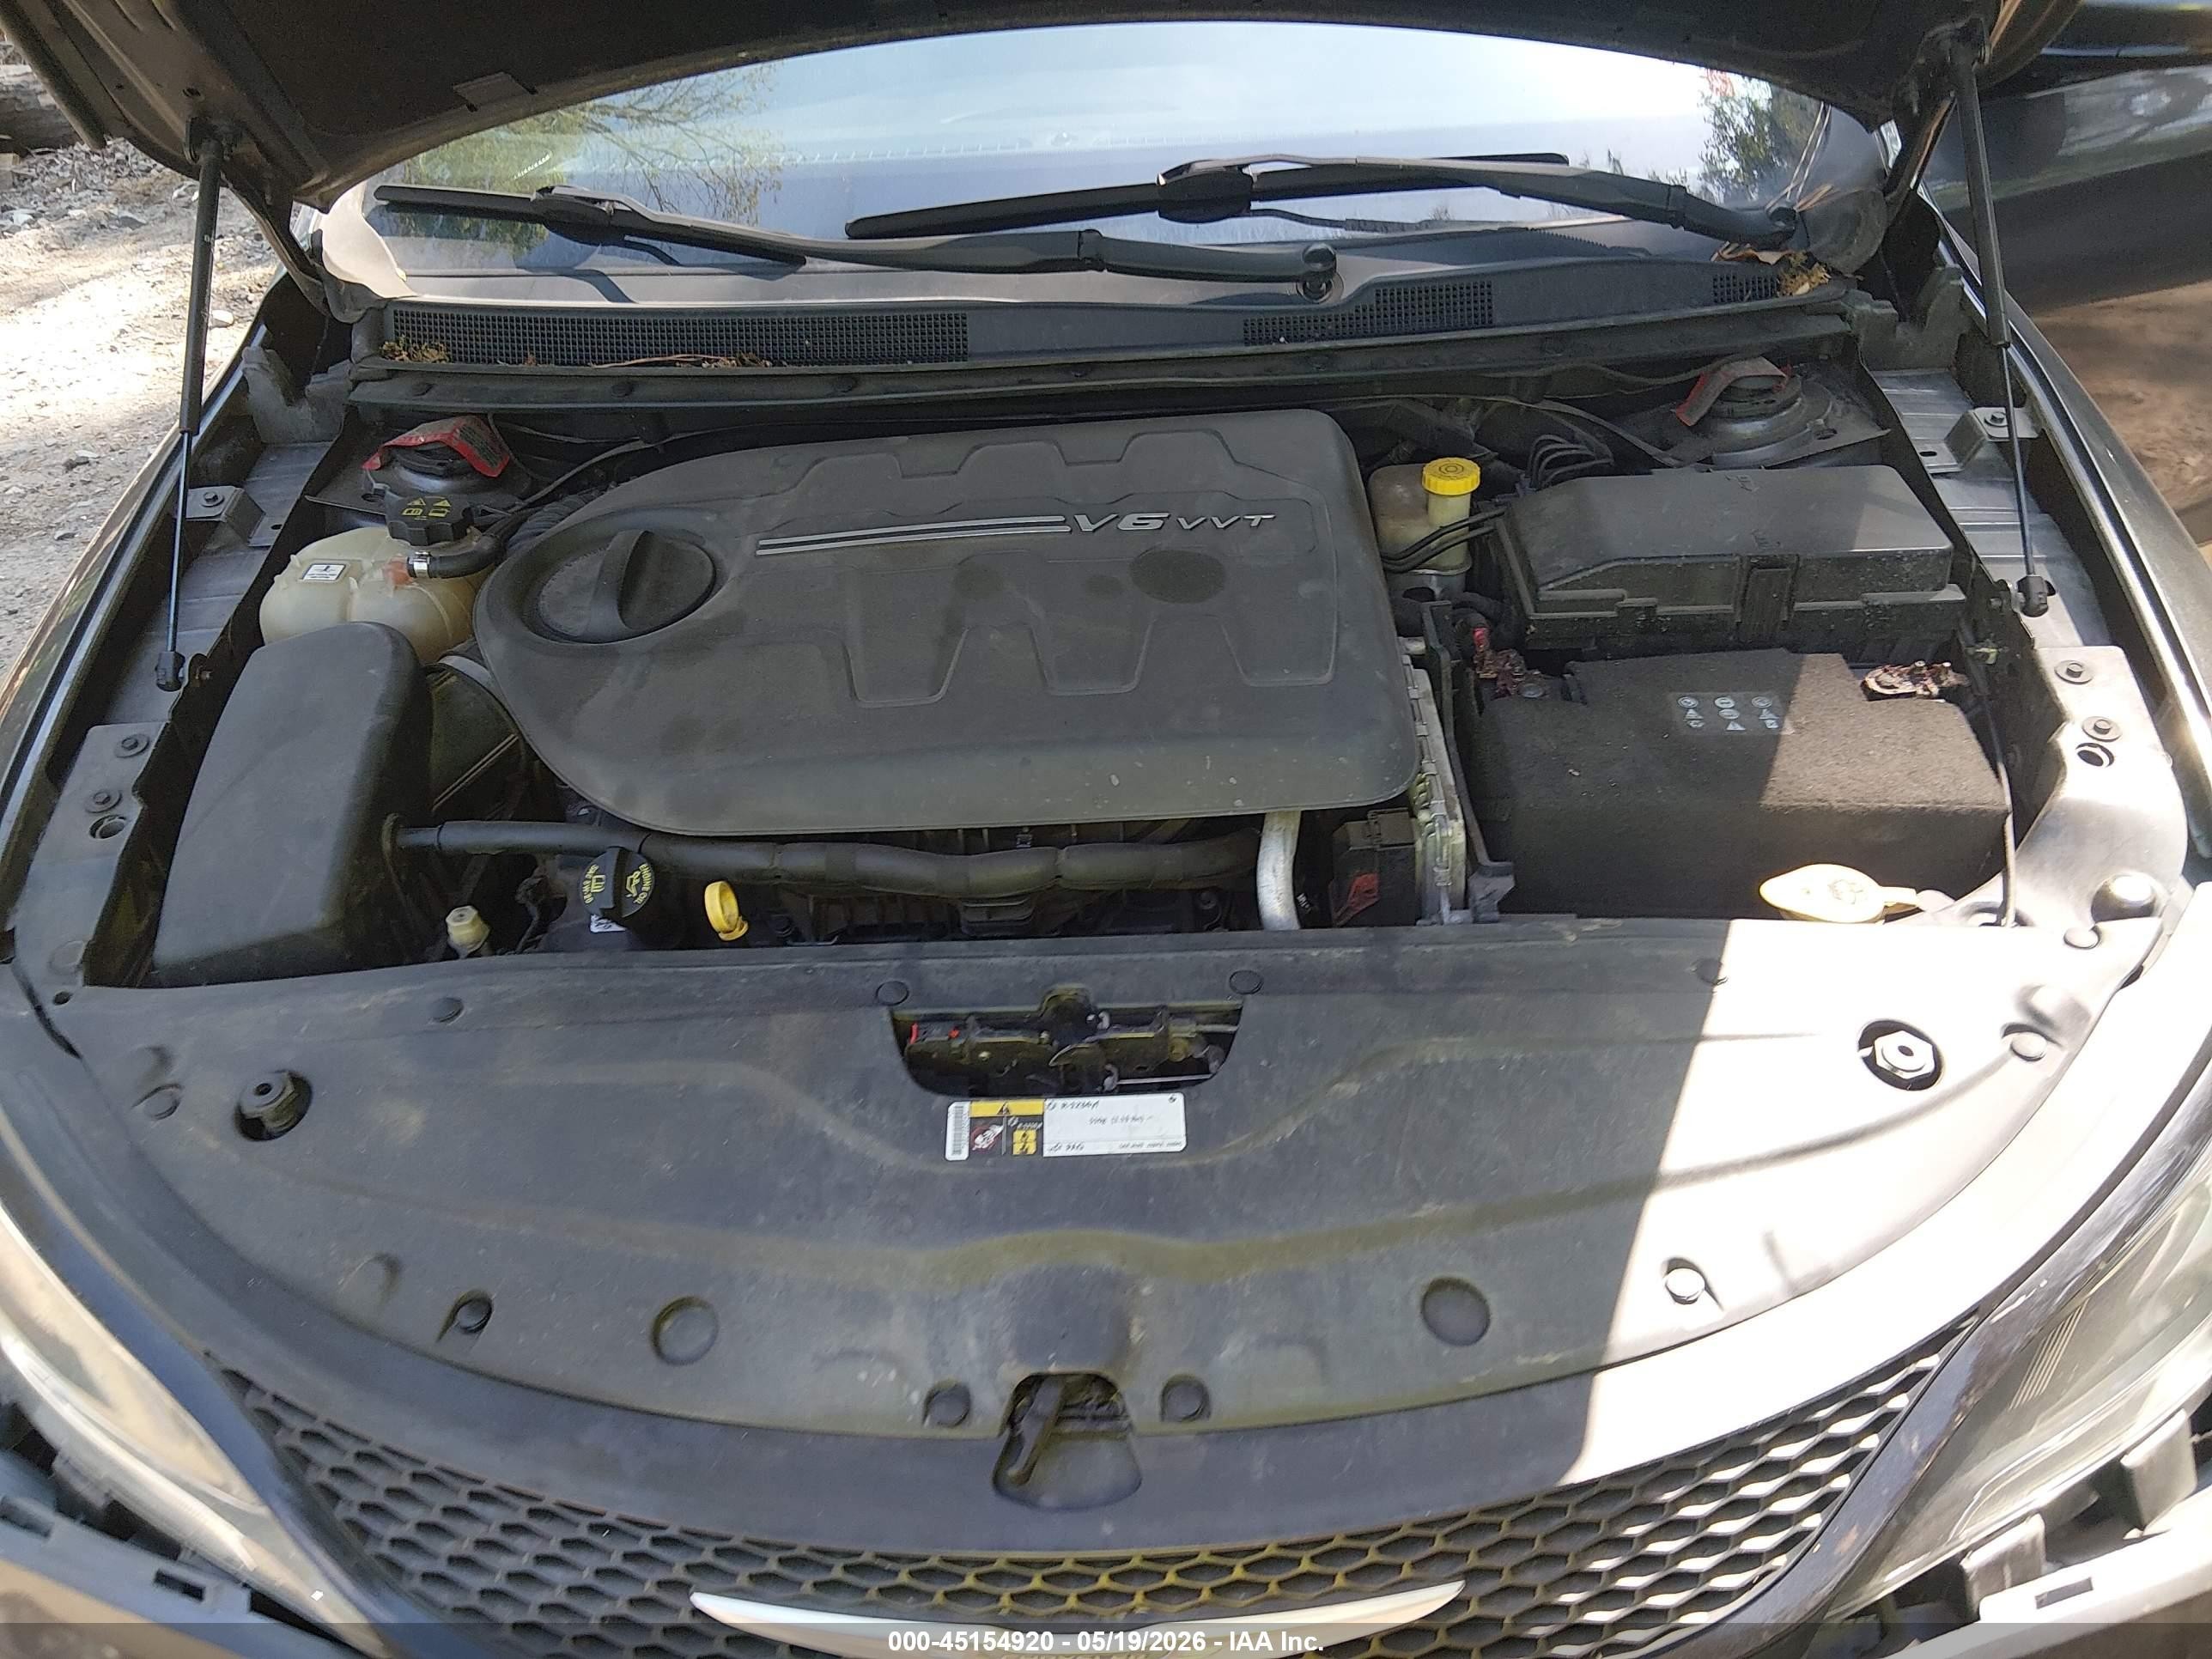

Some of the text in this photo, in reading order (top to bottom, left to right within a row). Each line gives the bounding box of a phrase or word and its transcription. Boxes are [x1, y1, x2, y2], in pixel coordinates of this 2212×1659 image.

[1073, 514, 1277, 532] V6 VVT
[633, 863, 653, 905] ENGINE OIL
